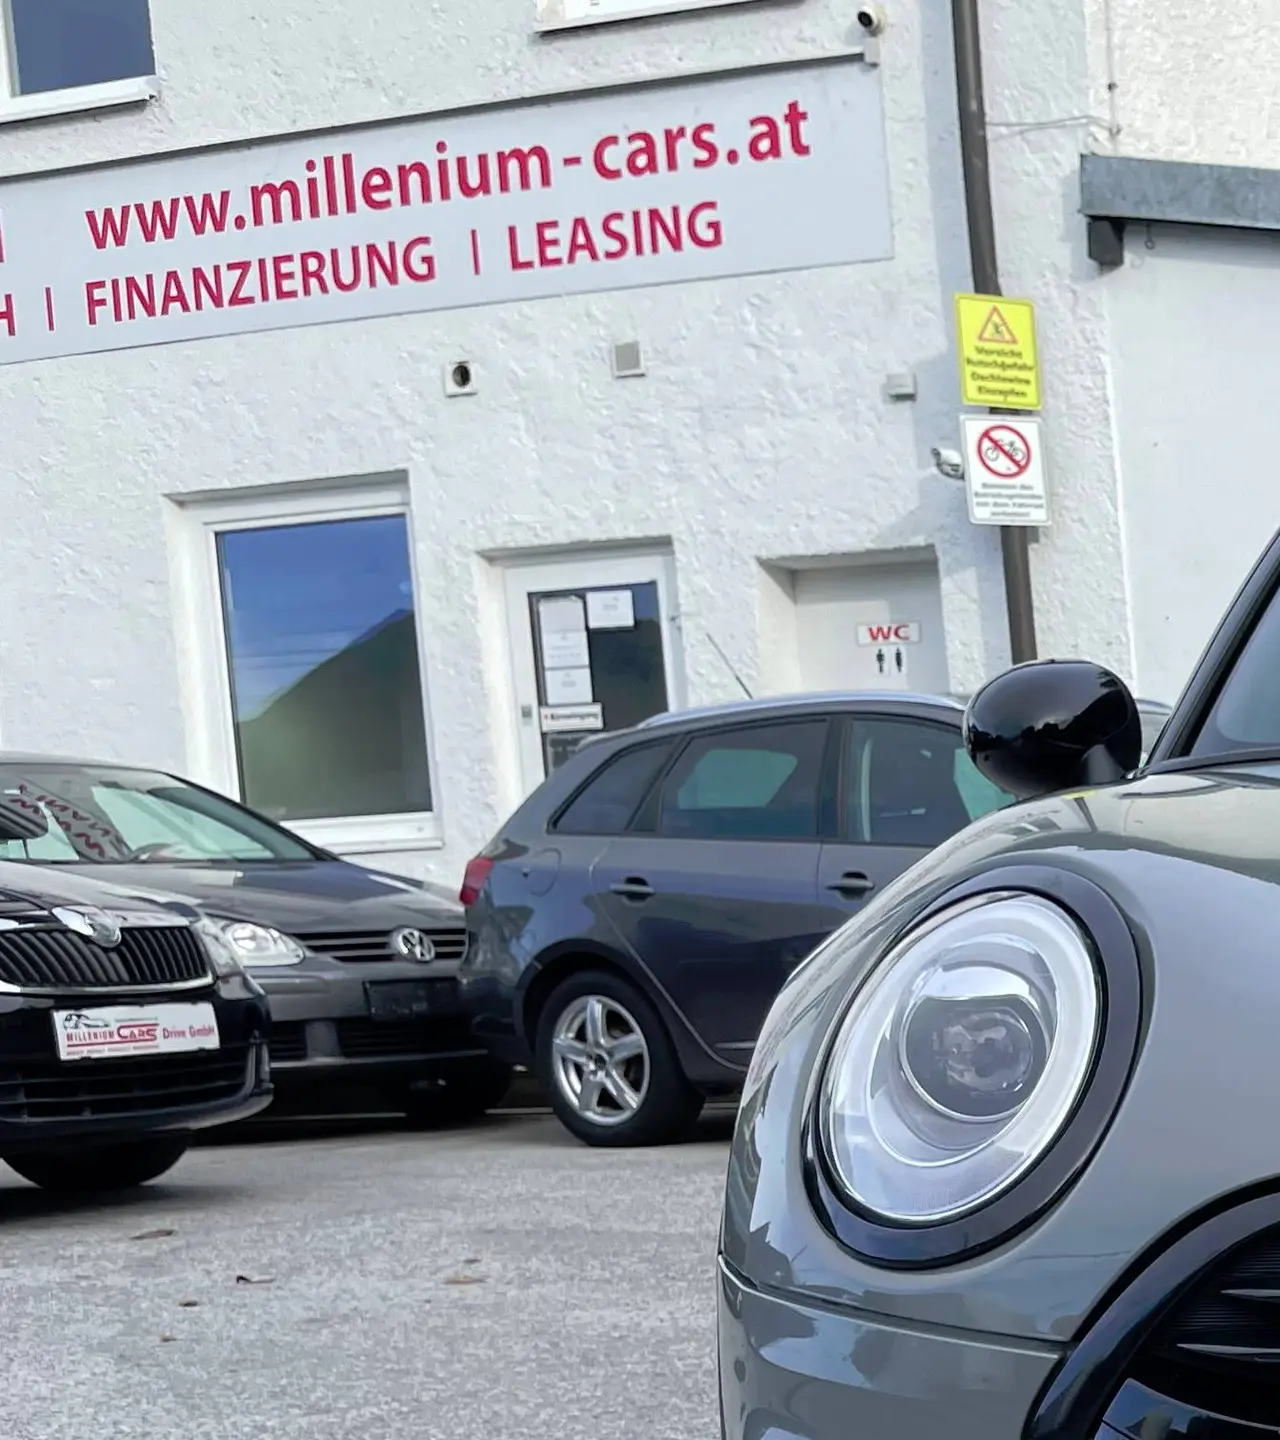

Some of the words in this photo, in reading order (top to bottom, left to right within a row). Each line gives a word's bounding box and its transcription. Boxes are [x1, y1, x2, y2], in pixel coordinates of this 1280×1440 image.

[85, 100, 811, 250] www.millenium-cars.at
[85, 236, 436, 326] FINANZIERUNG
[508, 200, 723, 272] LEASING
[868, 624, 910, 641] WC
